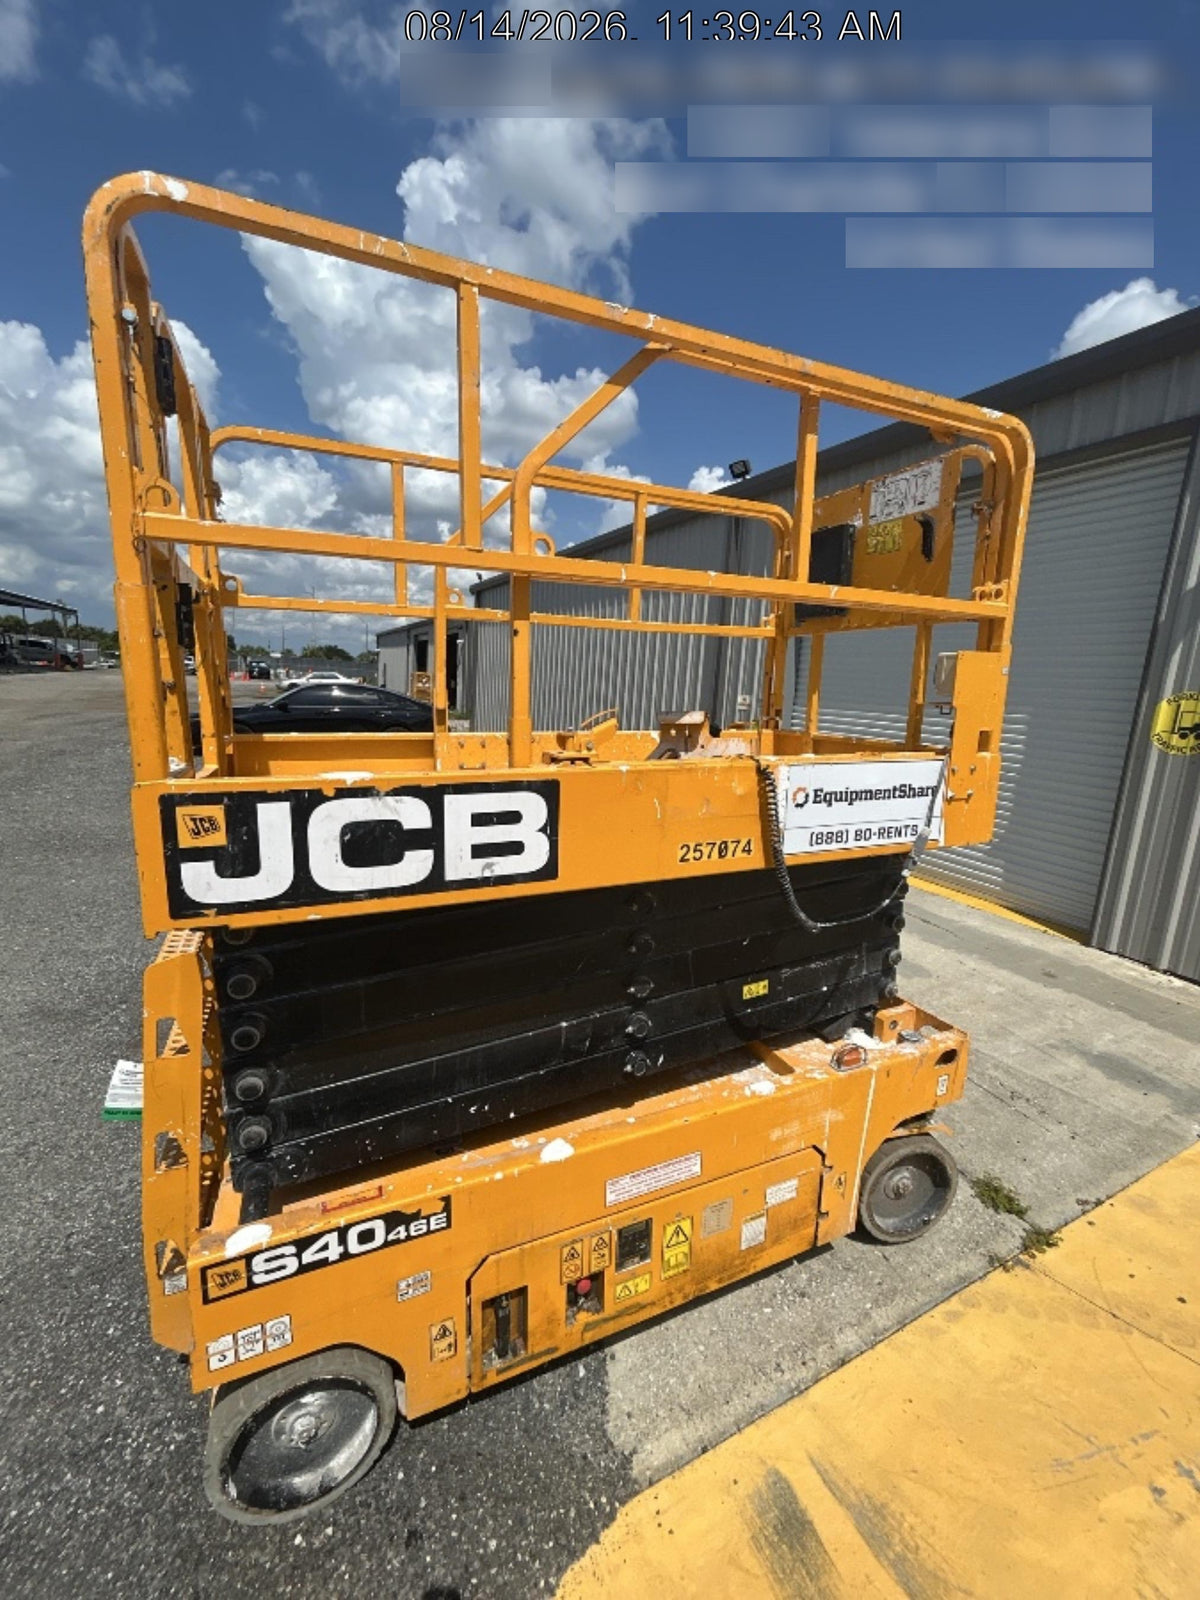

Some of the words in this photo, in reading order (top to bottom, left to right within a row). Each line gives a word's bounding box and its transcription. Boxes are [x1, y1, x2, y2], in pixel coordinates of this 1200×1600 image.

[187, 816, 219, 838] JCB
[809, 829, 849, 847] (888)
[181, 791, 550, 904] JCB
[679, 839, 753, 863] 257074
